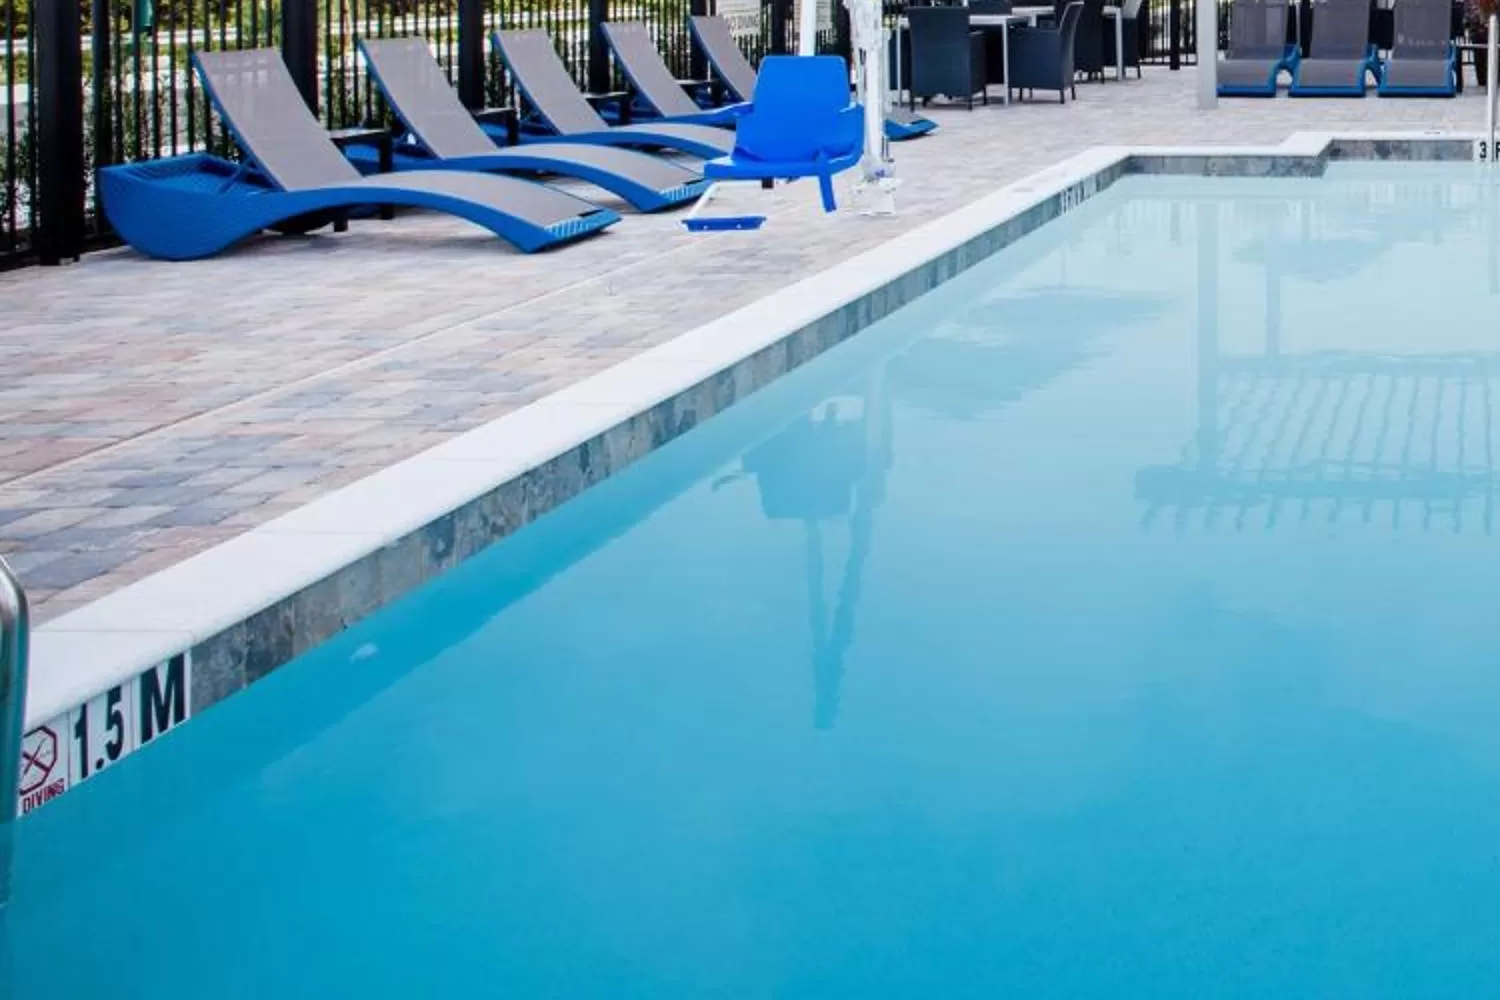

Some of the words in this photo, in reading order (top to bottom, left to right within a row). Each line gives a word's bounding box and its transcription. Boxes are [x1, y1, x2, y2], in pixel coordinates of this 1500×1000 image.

[1479, 141, 1487, 159] 3
[74, 685, 124, 780] 1.5
[140, 652, 185, 744] M
